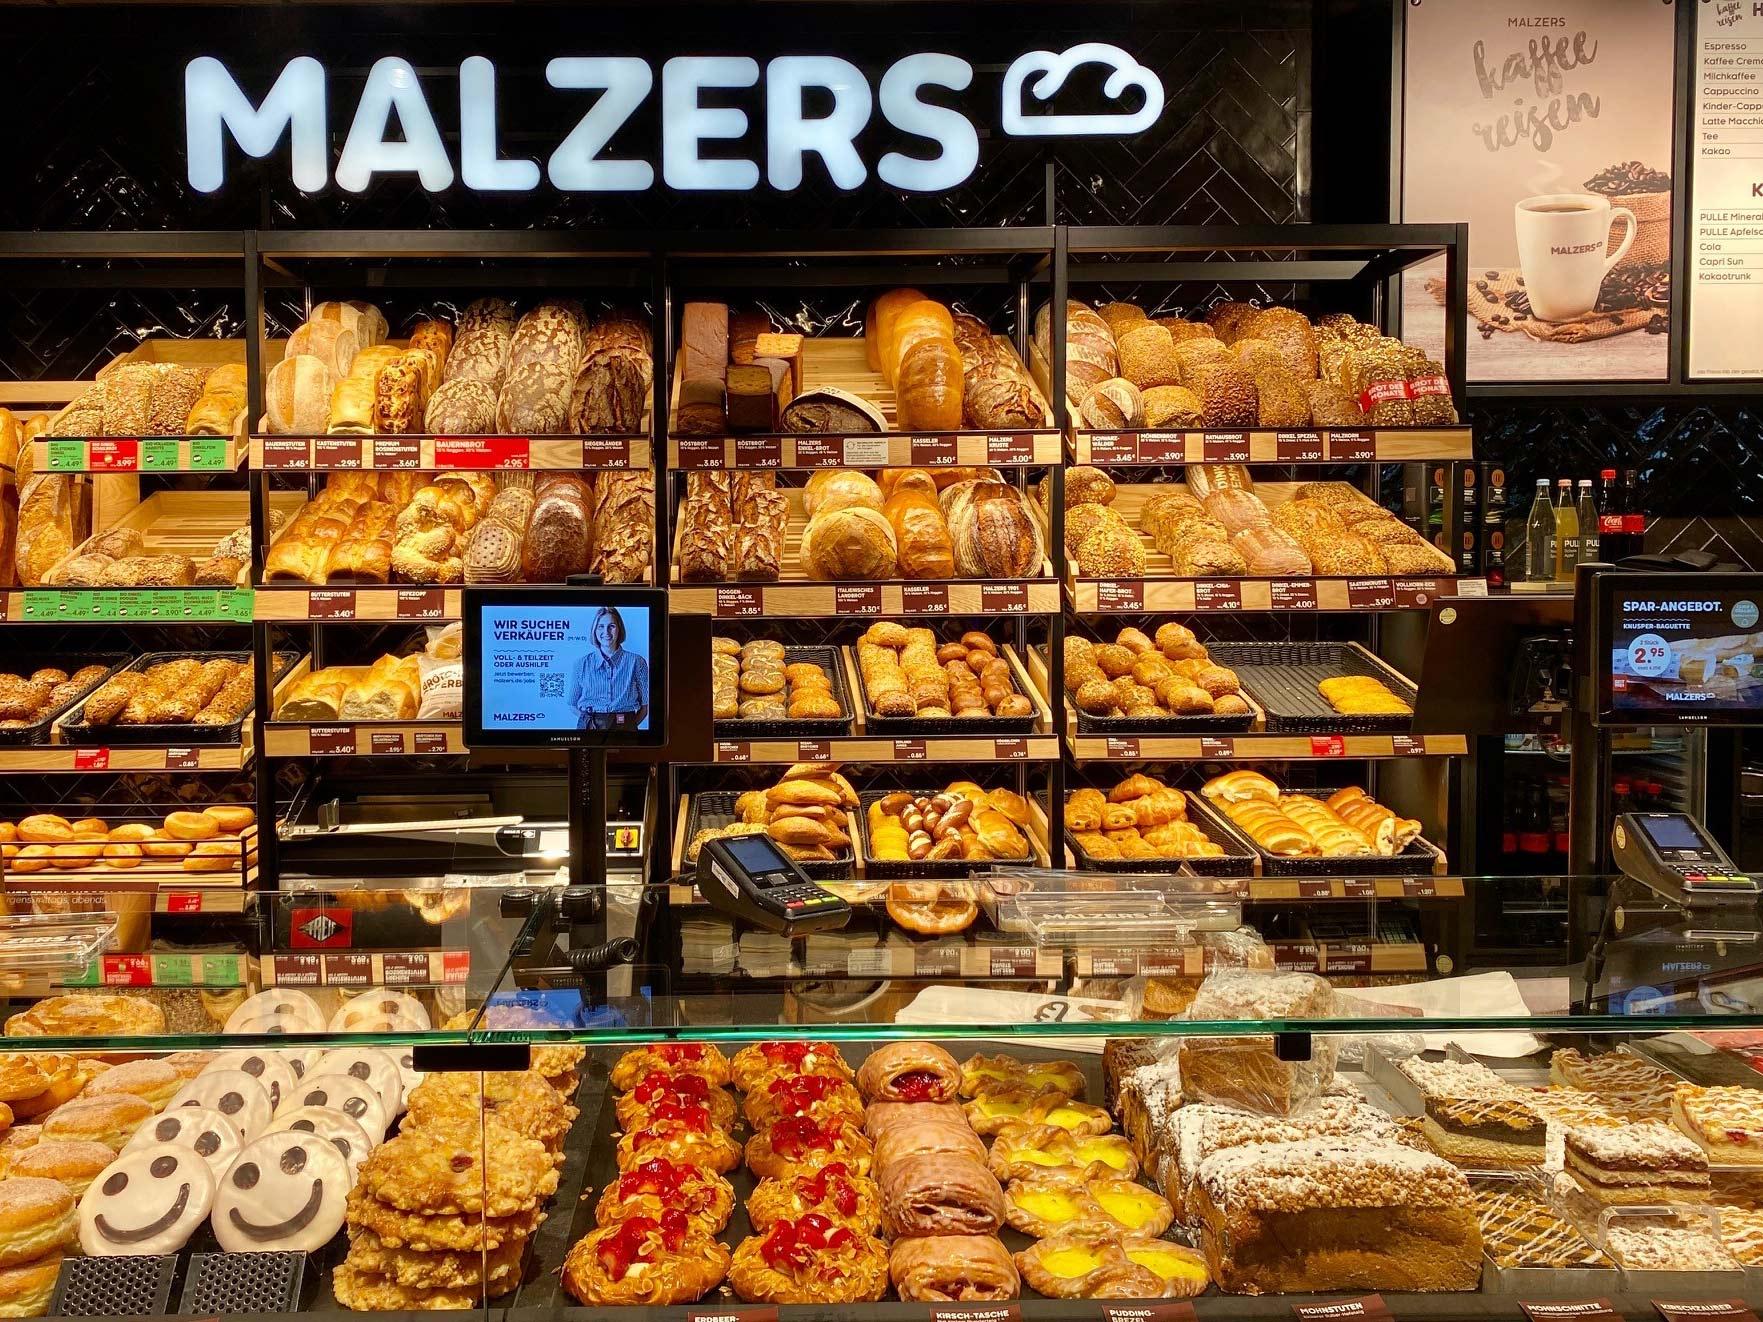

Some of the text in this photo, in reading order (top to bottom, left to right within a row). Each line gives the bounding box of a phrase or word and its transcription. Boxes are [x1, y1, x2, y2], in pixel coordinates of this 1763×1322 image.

[1508, 17, 1566, 27] MALZERS
[1704, 42, 1747, 51] Espresso
[1473, 30, 1598, 99] kaffee
[1703, 57, 1734, 65] Kaffee
[1703, 72, 1756, 80] Milchkaffee
[1703, 87, 1759, 97] Cappuccino
[1702, 102, 1763, 112] Kinder-Capp
[185, 53, 979, 193] MALZERS
[1472, 92, 1600, 152] reisen
[1702, 117, 1727, 125] Latte
[1702, 132, 1718, 140] Tee
[1701, 147, 1731, 155] Kakao
[1700, 213, 1728, 221] PULLE
[1700, 228, 1728, 236] PULLE
[1551, 243, 1596, 255] MALZERS
[1699, 243, 1721, 251] Cola
[1699, 257, 1744, 267] Capri Sun
[1699, 272, 1751, 281] Kakaotrunk
[1368, 384, 1388, 394] BROT
[1410, 380, 1432, 391] BROT
[436, 441, 486, 449] BAUERNBROT
[1165, 452, 1183, 460] 3.90€
[1229, 452, 1249, 460] 3.90€
[289, 459, 309, 467] 3.45€
[341, 459, 360, 467] 2.95€
[400, 459, 419, 467] 3.60€
[504, 459, 527, 467] 2.95€
[608, 459, 627, 467] 3.45€
[703, 459, 723, 467] 3.85€
[761, 458, 780, 466] 3.45€
[822, 458, 841, 466] 3.95€
[1295, 600, 1315, 608] 4.00€
[1375, 597, 1393, 606] 3.90€
[1623, 601, 1723, 612] SPAR-ANGEBOT.
[334, 609, 354, 617] 3.40€
[422, 609, 442, 617] 3.60€
[742, 607, 761, 615] 3.85€
[493, 620, 570, 630] WIR SUCHEN
[493, 630, 565, 641] VERKÄUFER
[1665, 693, 1706, 701] MALZERS
[493, 713, 536, 721] MALZERS
[335, 745, 354, 753] 3.40€
[1299, 1302, 1364, 1315] MOHNSTUTEN
[1527, 1302, 1602, 1312] MOHNSCHNITTE
[1660, 1303, 1733, 1312] KIRSCHZAUBER
[936, 1309, 1010, 1319] KIRSCH-TASCHE
[1109, 1310, 1155, 1318] PUDDING-
